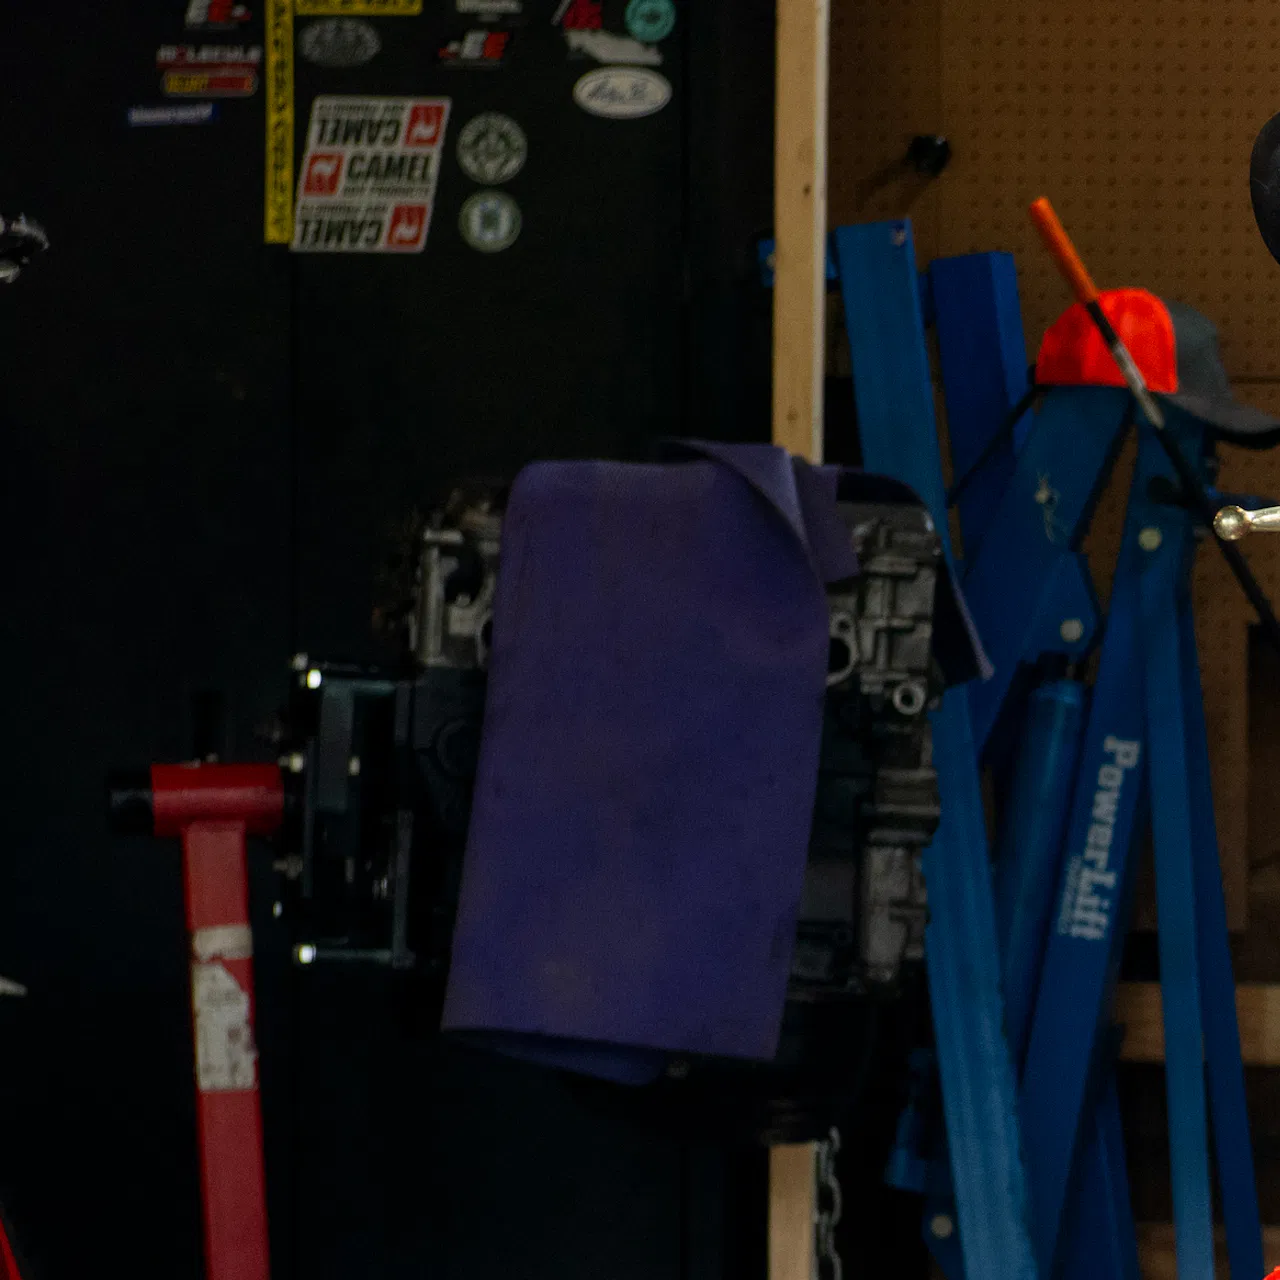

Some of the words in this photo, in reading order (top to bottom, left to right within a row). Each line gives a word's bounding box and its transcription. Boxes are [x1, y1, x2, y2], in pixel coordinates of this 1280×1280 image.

[317, 119, 402, 146] CAMEL
[345, 152, 433, 181] CAMEL
[299, 219, 384, 244] CAMEL
